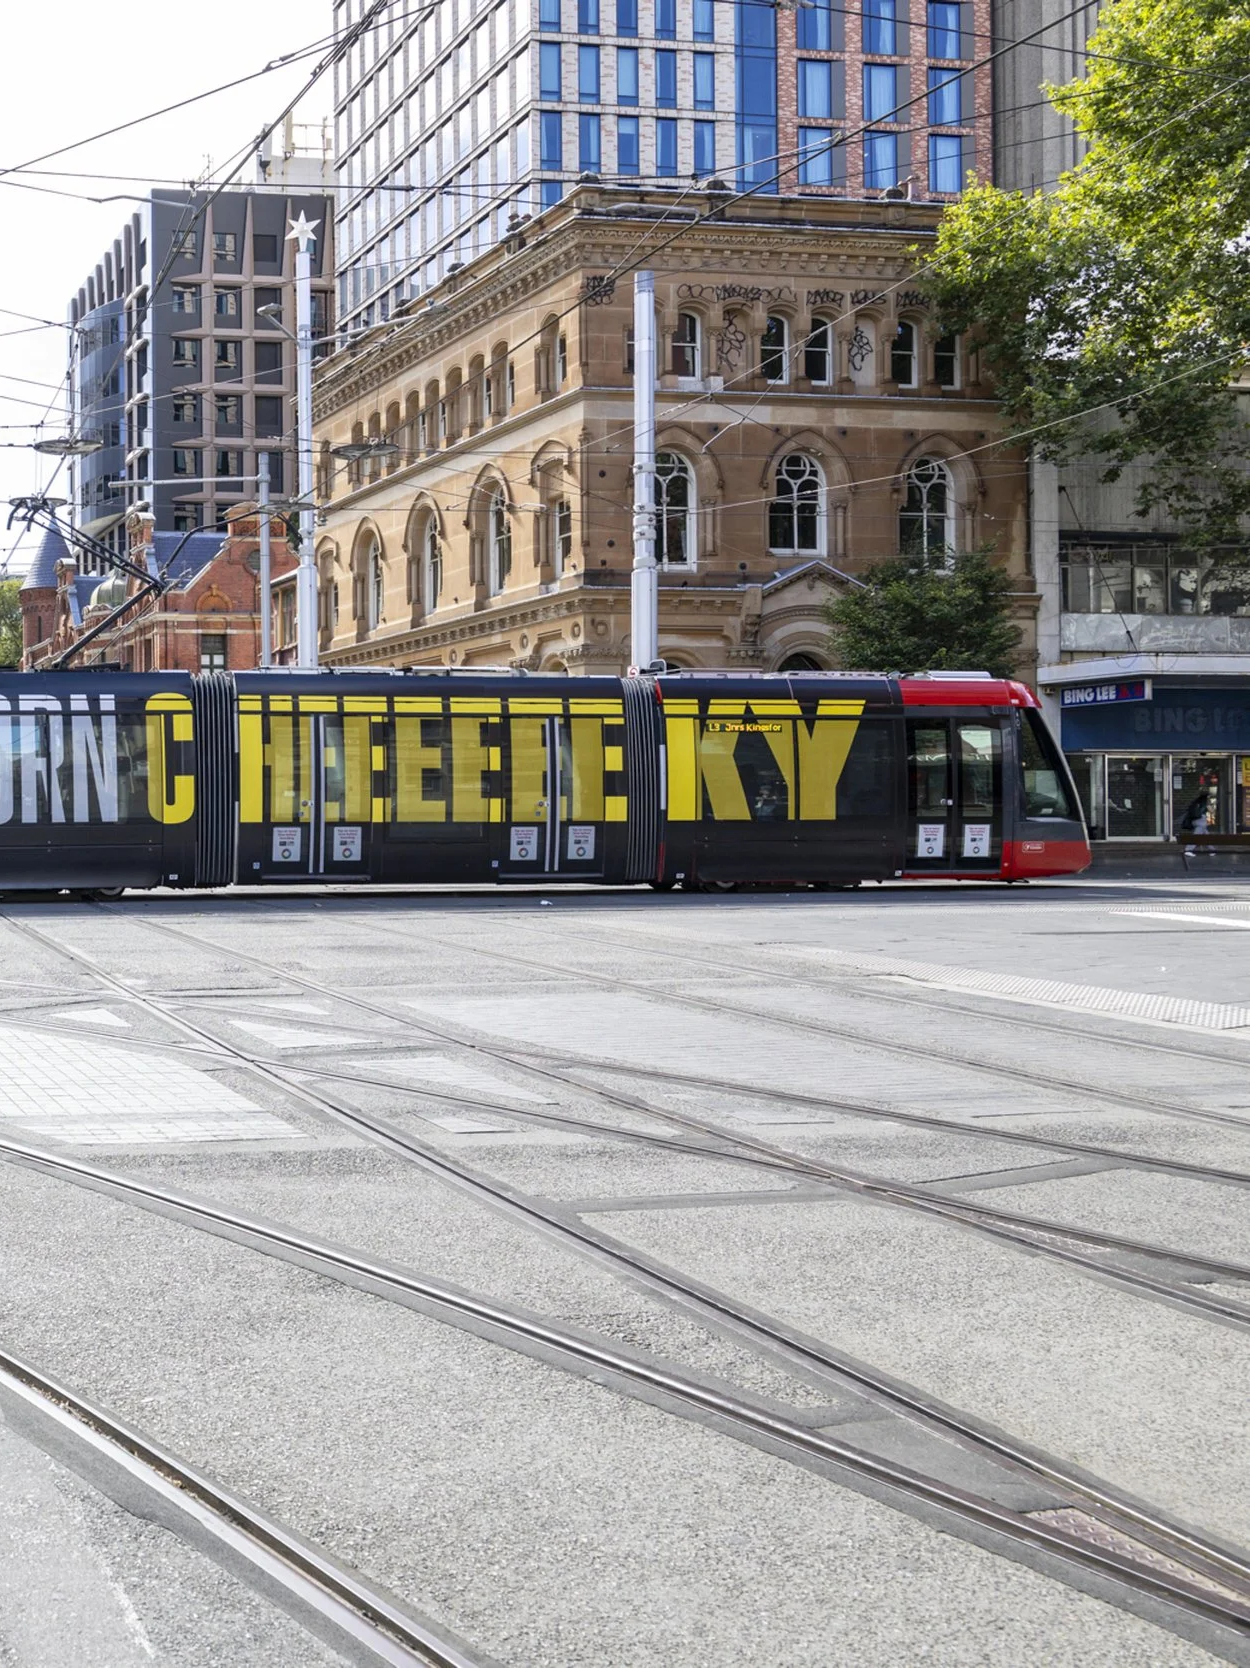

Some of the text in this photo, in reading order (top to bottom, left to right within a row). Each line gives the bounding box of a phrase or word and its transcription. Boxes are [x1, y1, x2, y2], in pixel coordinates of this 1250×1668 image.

[1063, 687, 1094, 704] BING
[1096, 684, 1117, 701] LEE
[709, 723, 720, 732] L3
[725, 723, 745, 732] Jnrs
[1134, 707, 1207, 733] BING
